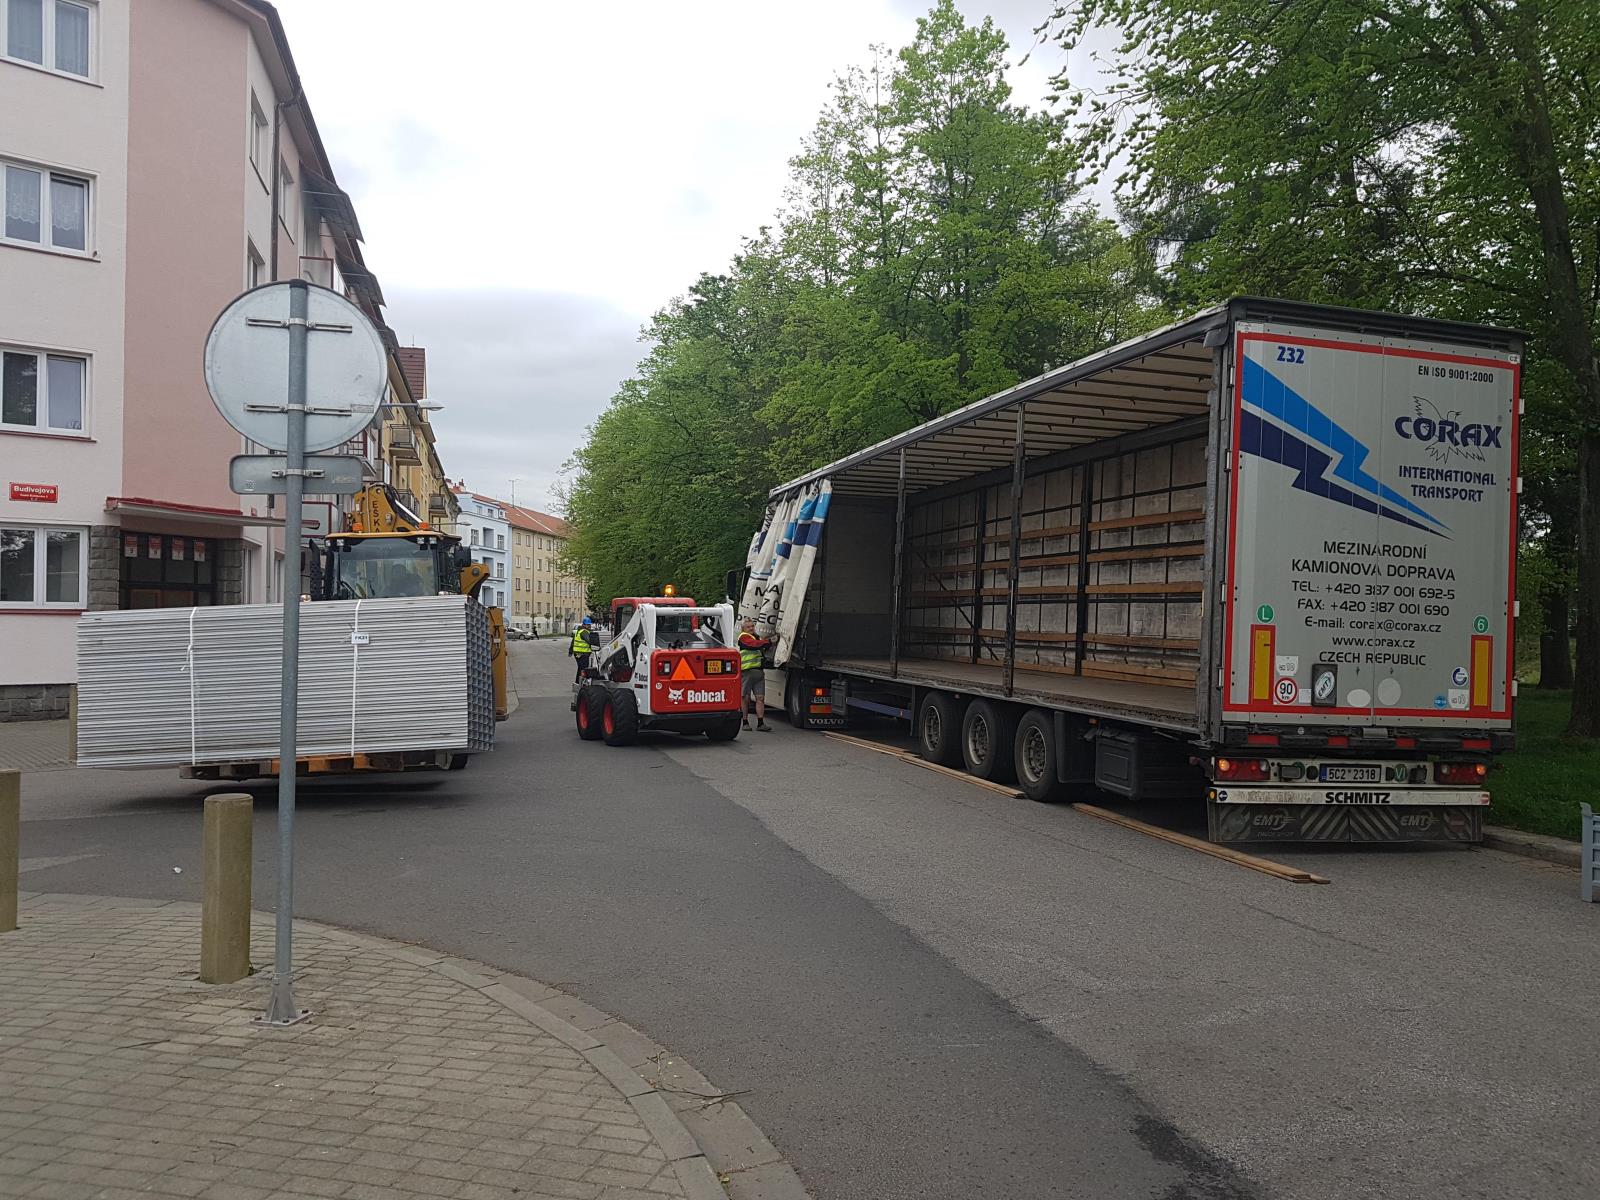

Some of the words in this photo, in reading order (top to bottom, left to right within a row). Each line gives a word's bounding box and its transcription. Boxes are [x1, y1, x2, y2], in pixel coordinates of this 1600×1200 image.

[1276, 345, 1305, 364] 232
[1418, 365, 1430, 377] EN
[1431, 367, 1446, 378] ISO
[1448, 369, 1494, 383] 9001:2000
[1394, 416, 1502, 448] CORAX
[1399, 465, 1497, 486] INTERNATIONAL
[13, 485, 55, 495] Budivojova
[1410, 484, 1484, 502] TRANSPORT
[1386, 564, 1456, 582] DOPRAVA
[1325, 582, 1361, 596] +420
[1365, 584, 1390, 596] 387
[1393, 585, 1415, 598] 001
[1418, 587, 1456, 600] 692-5
[1297, 598, 1325, 611] FAX:
[1330, 600, 1366, 613] +420
[1399, 602, 1420, 615] 001
[1424, 604, 1450, 617] 690
[1304, 615, 1345, 629] E-mail:
[1349, 618, 1442, 634] corax@corax.cz
[1332, 636, 1416, 649] www.corax.cz
[1319, 651, 1361, 664] CZECH
[1365, 652, 1427, 667] REPUBLIC
[687, 689, 726, 704] Bobcat
[1279, 682, 1293, 695] 90
[1328, 768, 1347, 781] 5C2
[1352, 768, 1377, 781] 2318
[1325, 791, 1391, 804] SCHMITZ
